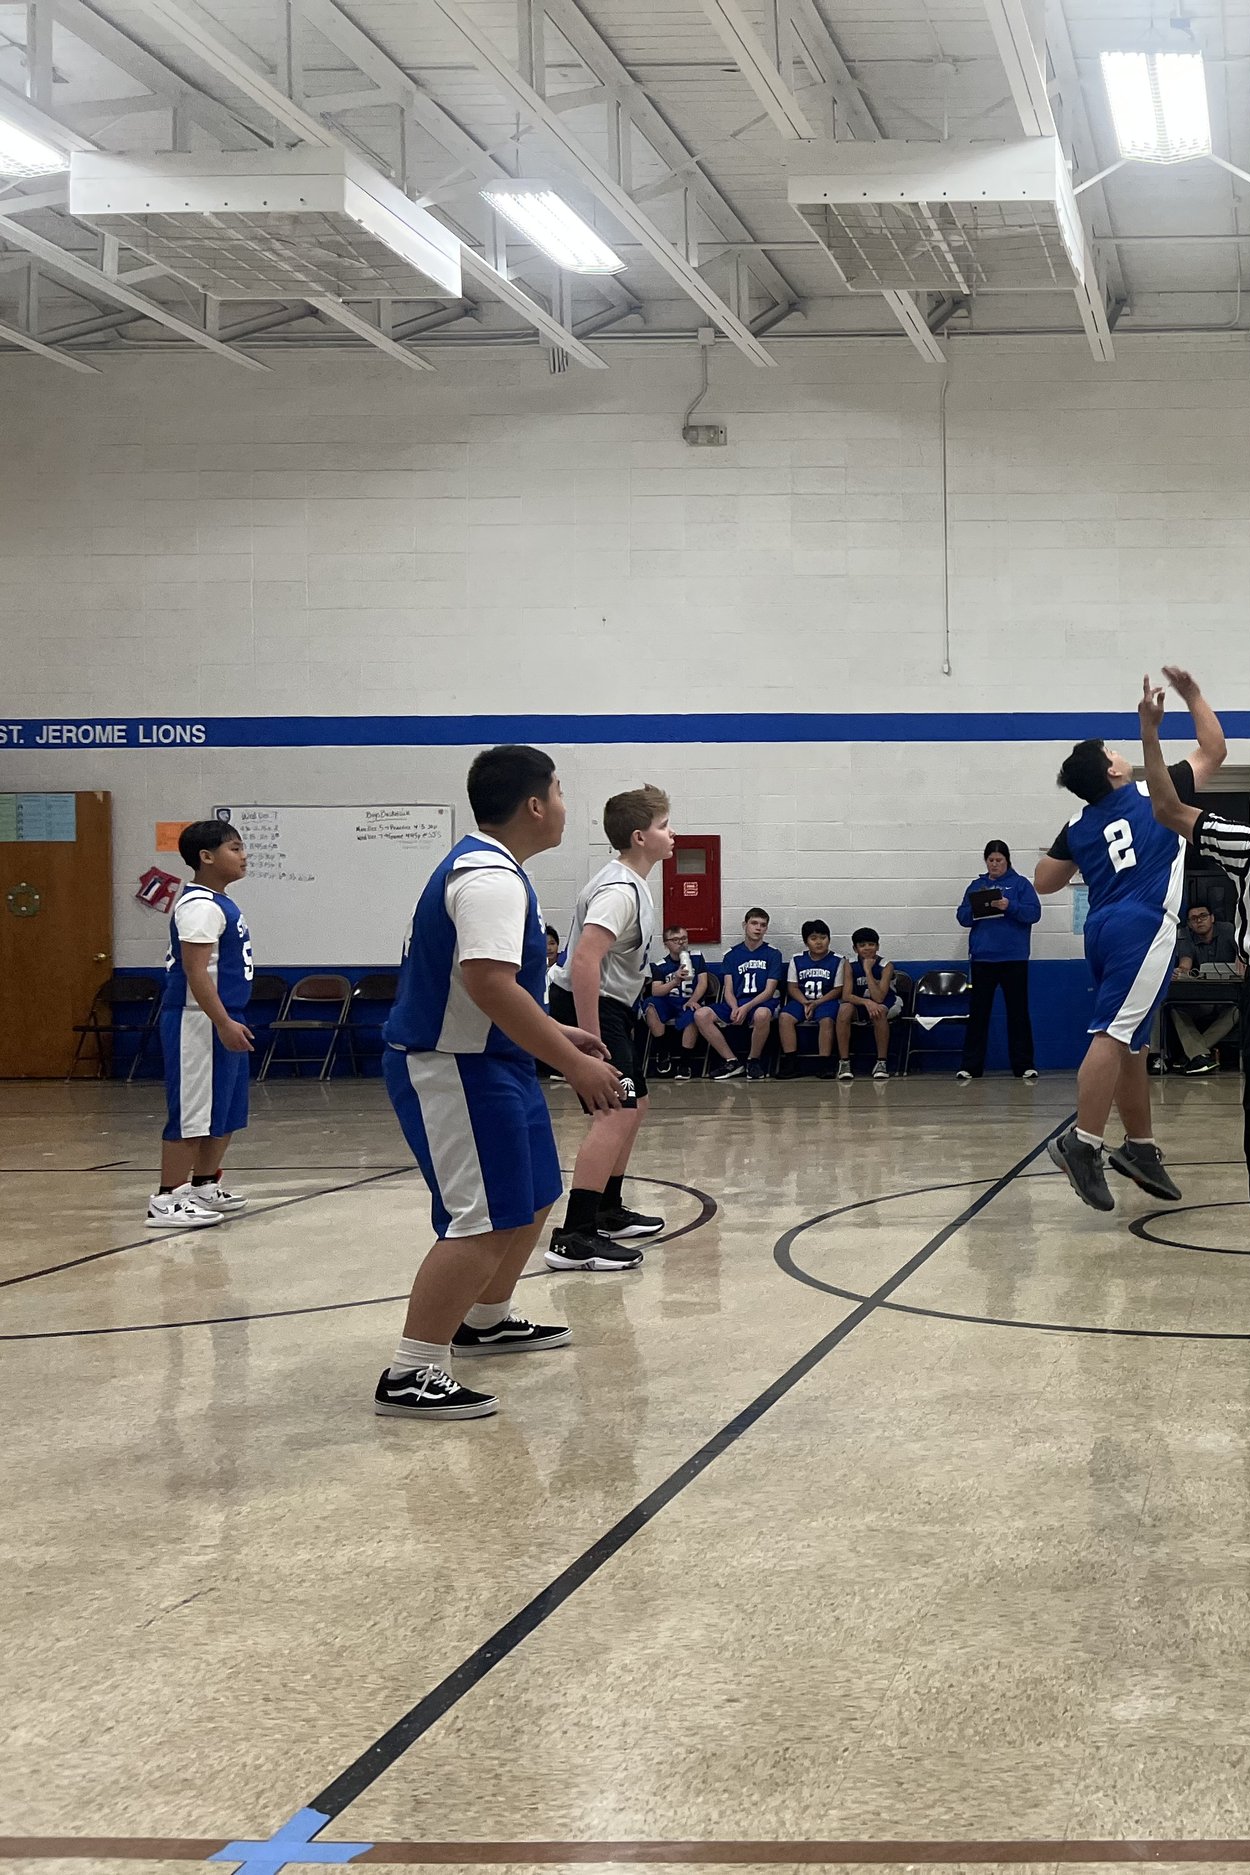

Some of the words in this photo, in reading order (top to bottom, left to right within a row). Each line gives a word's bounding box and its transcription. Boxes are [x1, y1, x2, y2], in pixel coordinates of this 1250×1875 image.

[0, 725, 25, 744] ST.
[35, 725, 128, 744] JEROME
[138, 724, 206, 743] LIONS
[1103, 818, 1137, 874] 2
[743, 973, 757, 993] 11
[804, 981, 823, 999] 21
